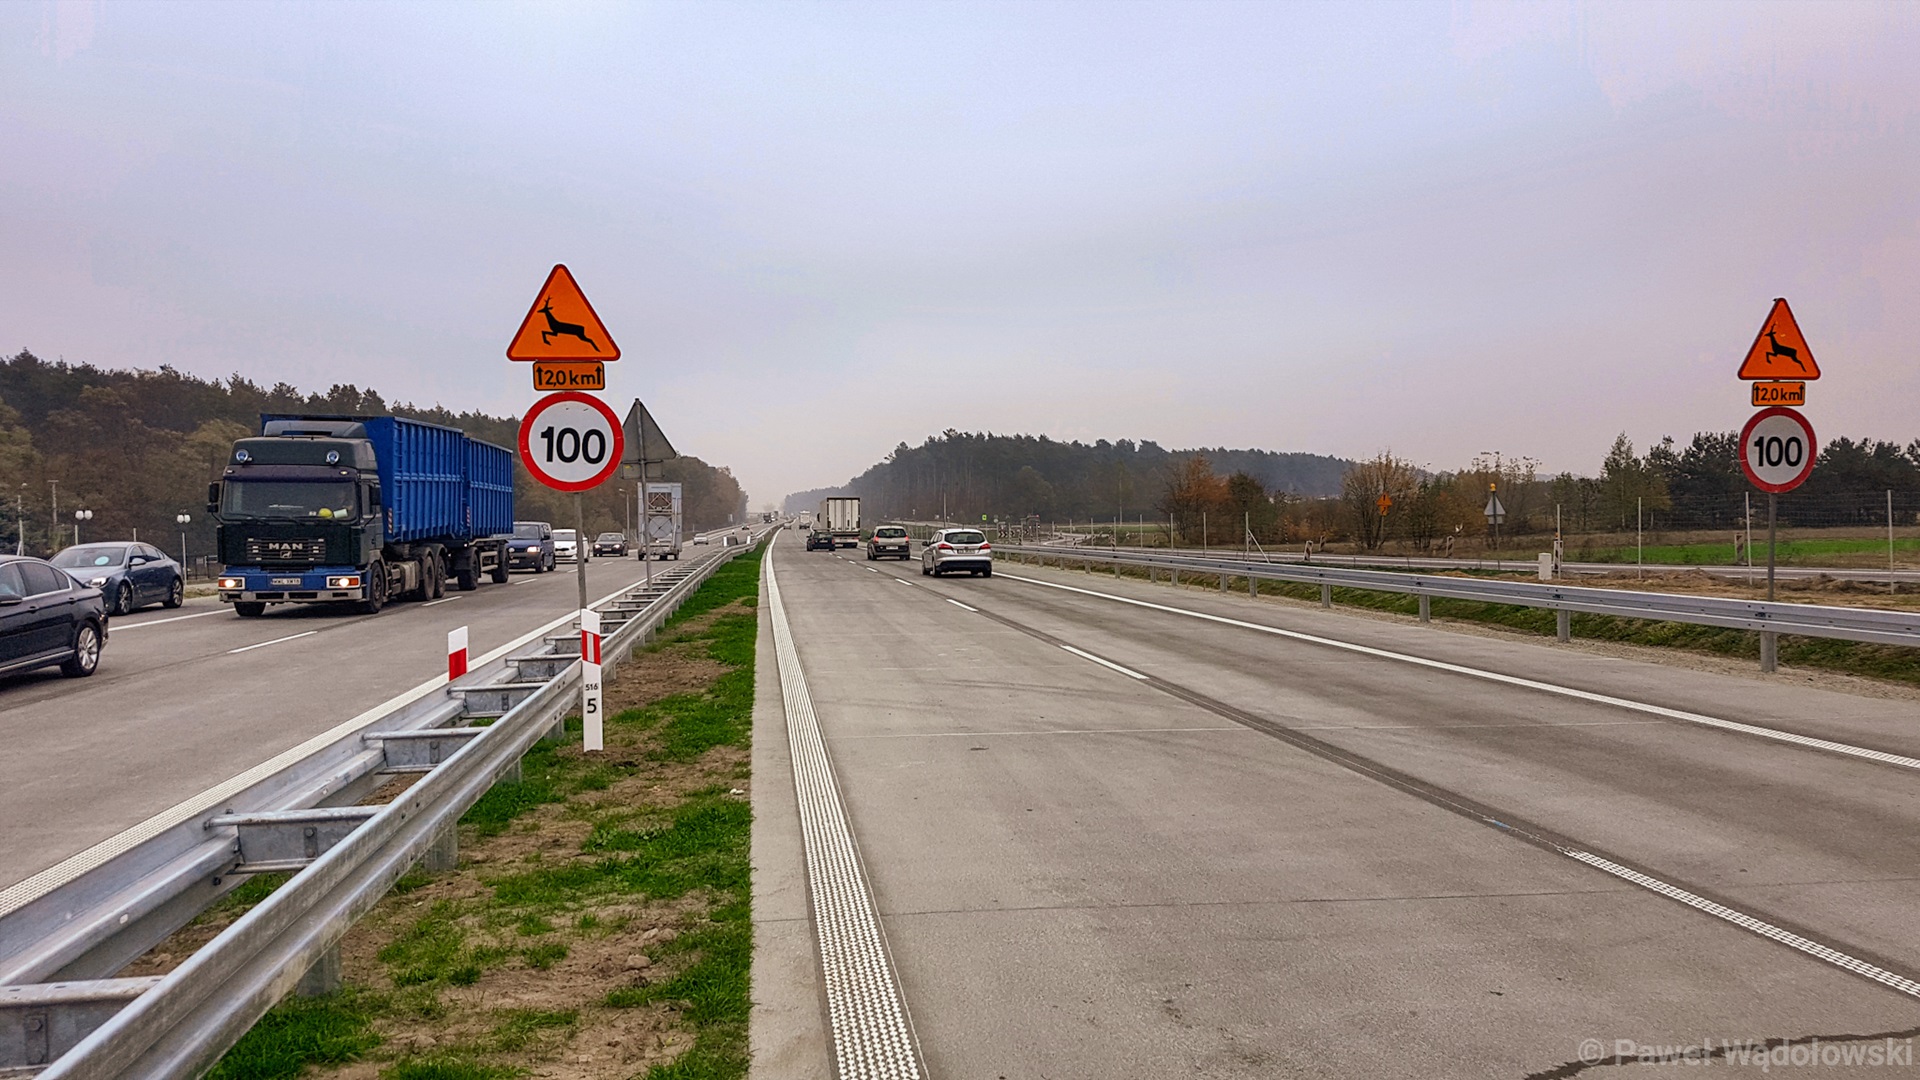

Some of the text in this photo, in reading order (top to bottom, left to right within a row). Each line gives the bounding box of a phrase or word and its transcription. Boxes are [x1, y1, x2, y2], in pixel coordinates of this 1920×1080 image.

[544, 370, 596, 387] 2,0 km
[1760, 388, 1800, 402] 2,0 km
[540, 426, 606, 465] 100
[1754, 436, 1803, 467] 100
[585, 683, 599, 691] 516
[587, 698, 597, 714] 5
